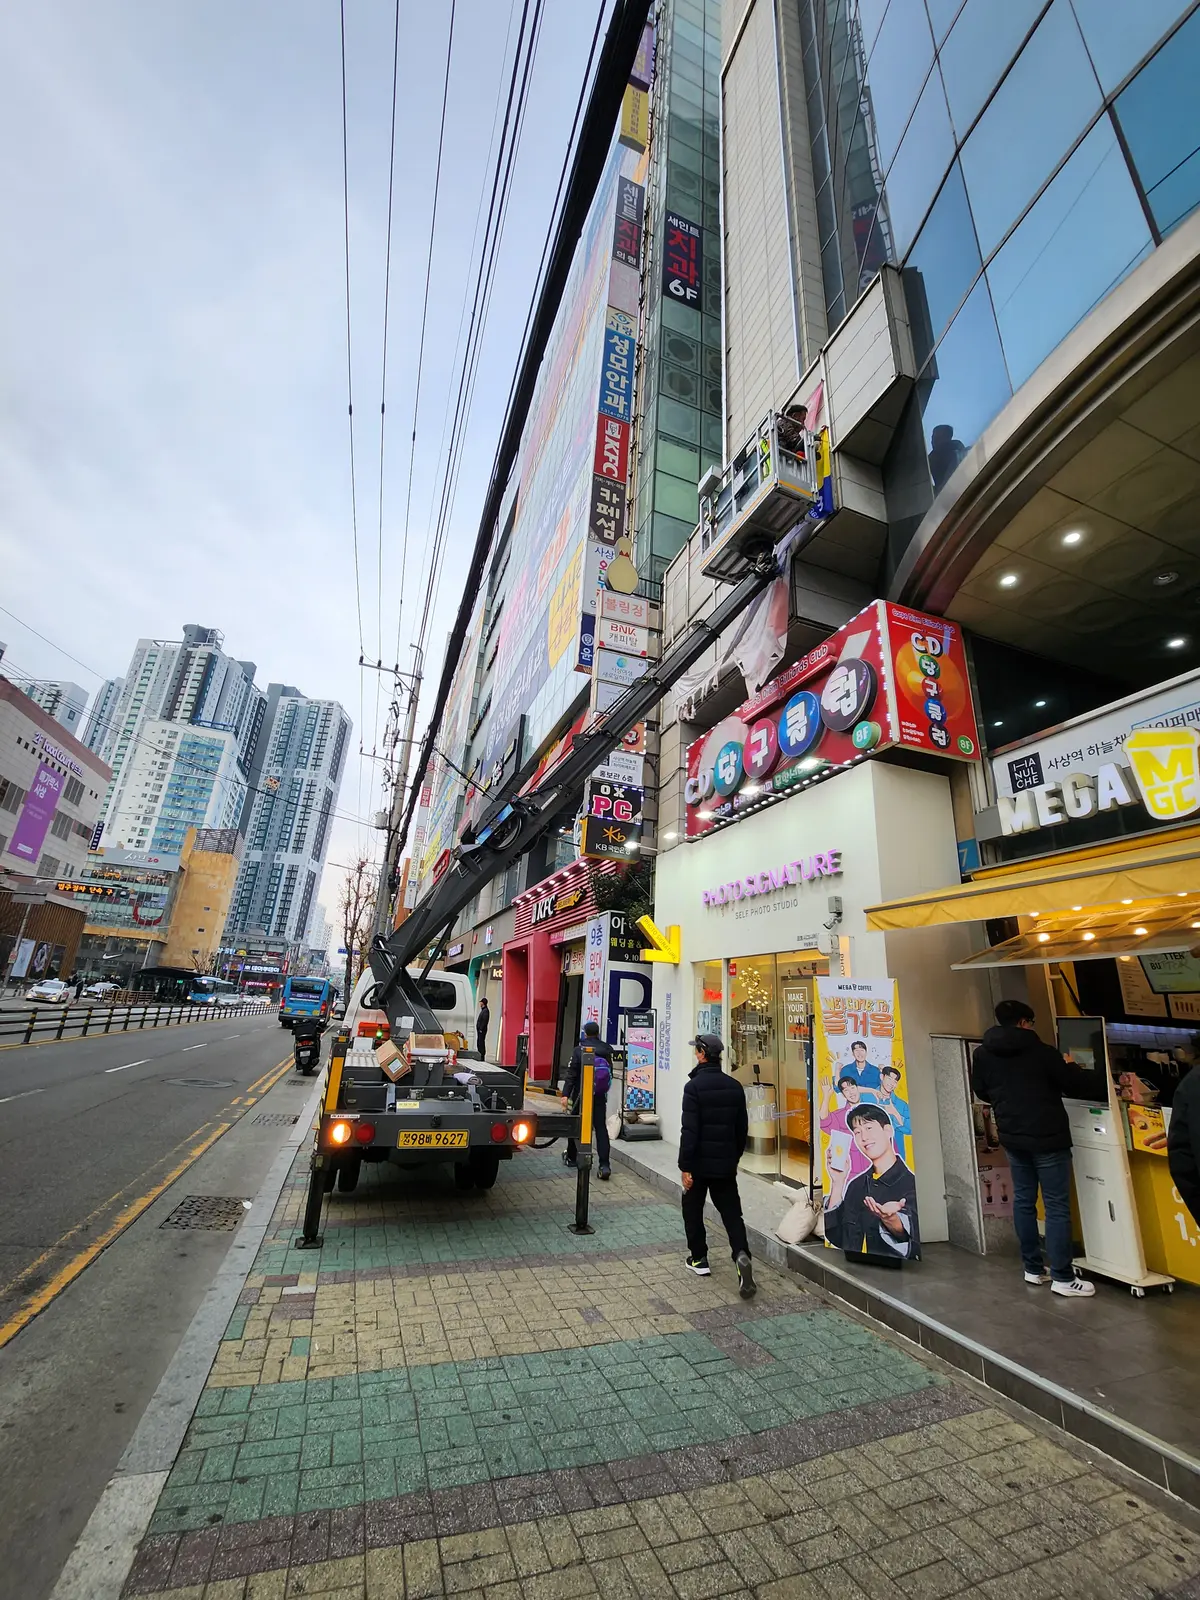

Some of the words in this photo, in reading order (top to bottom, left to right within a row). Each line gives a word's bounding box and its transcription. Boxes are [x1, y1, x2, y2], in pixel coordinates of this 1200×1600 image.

[622, 183, 638, 221] 세인트
[615, 219, 639, 256] 치과
[667, 215, 700, 238] 세인트
[667, 228, 699, 286] 치과
[668, 278, 698, 300] 6F
[603, 335, 630, 414] 성모안과
[603, 434, 620, 478] KFC
[596, 487, 620, 541] 카페섬
[594, 546, 615, 560] 사상
[605, 596, 643, 618] 볼링장
[608, 632, 638, 648] 캐피탈
[610, 622, 636, 637] BNK
[911, 632, 941, 656] CD
[779, 661, 809, 687] Billiards
[809, 644, 828, 664] Club
[921, 657, 948, 747] 당구클럽
[856, 728, 868, 742] 8F
[959, 739, 970, 749] 8F
[1047, 750, 1084, 770] 사상역
[600, 769, 621, 780] 홍보관
[1014, 769, 1038, 782] NUL
[1016, 777, 1040, 789] CHE
[601, 784, 625, 798] OX
[998, 762, 1134, 837] MEGA
[592, 795, 632, 820] PC
[702, 880, 744, 908] PHOTO
[744, 848, 842, 897] SIGNATURE
[537, 894, 556, 921] KFC
[735, 909, 749, 920] SELF
[750, 904, 771, 916] PHOTO
[773, 898, 799, 912] STUDIO
[591, 925, 604, 946] 9층
[610, 937, 634, 948] 웨딩홀
[656, 934, 678, 961] SIGNATURE
[606, 969, 654, 1046] P
[787, 992, 804, 1002] MAKE
[787, 1003, 805, 1013] YOUR
[824, 995, 875, 1012] WELCOME
[788, 1014, 805, 1025] OWN
[823, 1009, 895, 1038] 즐거움
[664, 992, 672, 1071] SIGNATURE
[657, 1020, 665, 1070] PHOTO
[435, 1133, 464, 1146] 9627
